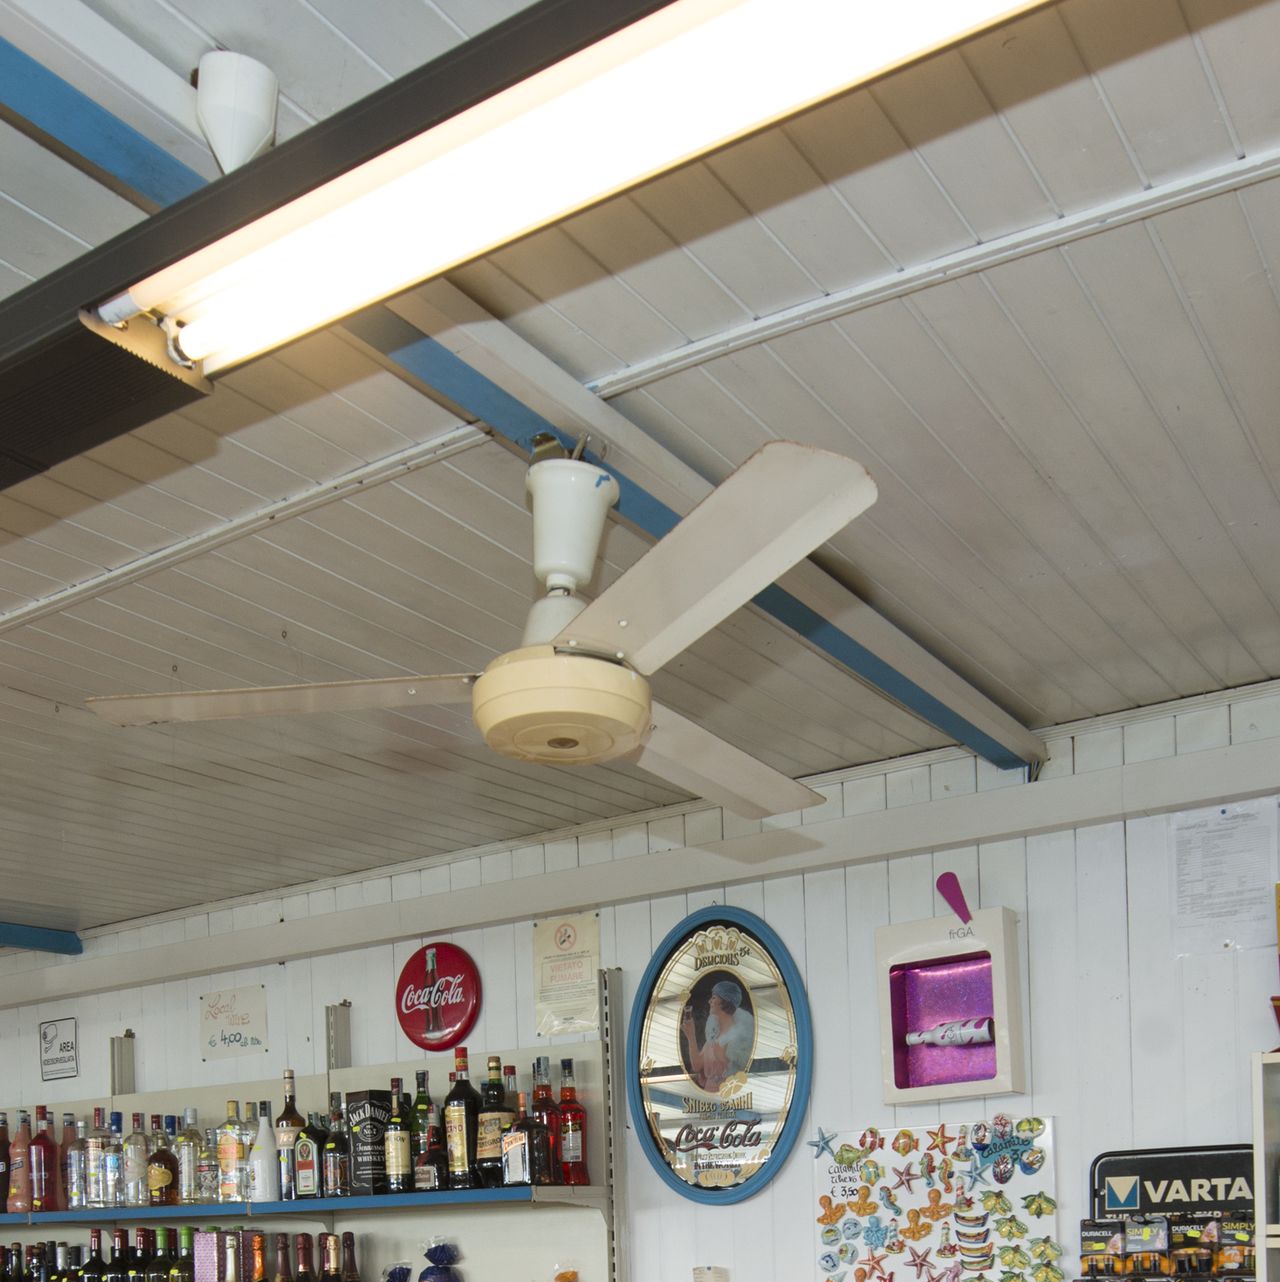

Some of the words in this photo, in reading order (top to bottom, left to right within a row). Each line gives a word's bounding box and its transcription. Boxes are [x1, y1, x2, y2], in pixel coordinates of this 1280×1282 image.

[60, 1042, 74, 1052] AREA
[350, 1104, 365, 1126] JACK
[1144, 1177, 1253, 1203] VARTA
[1222, 1222, 1256, 1230] SIMPLY
